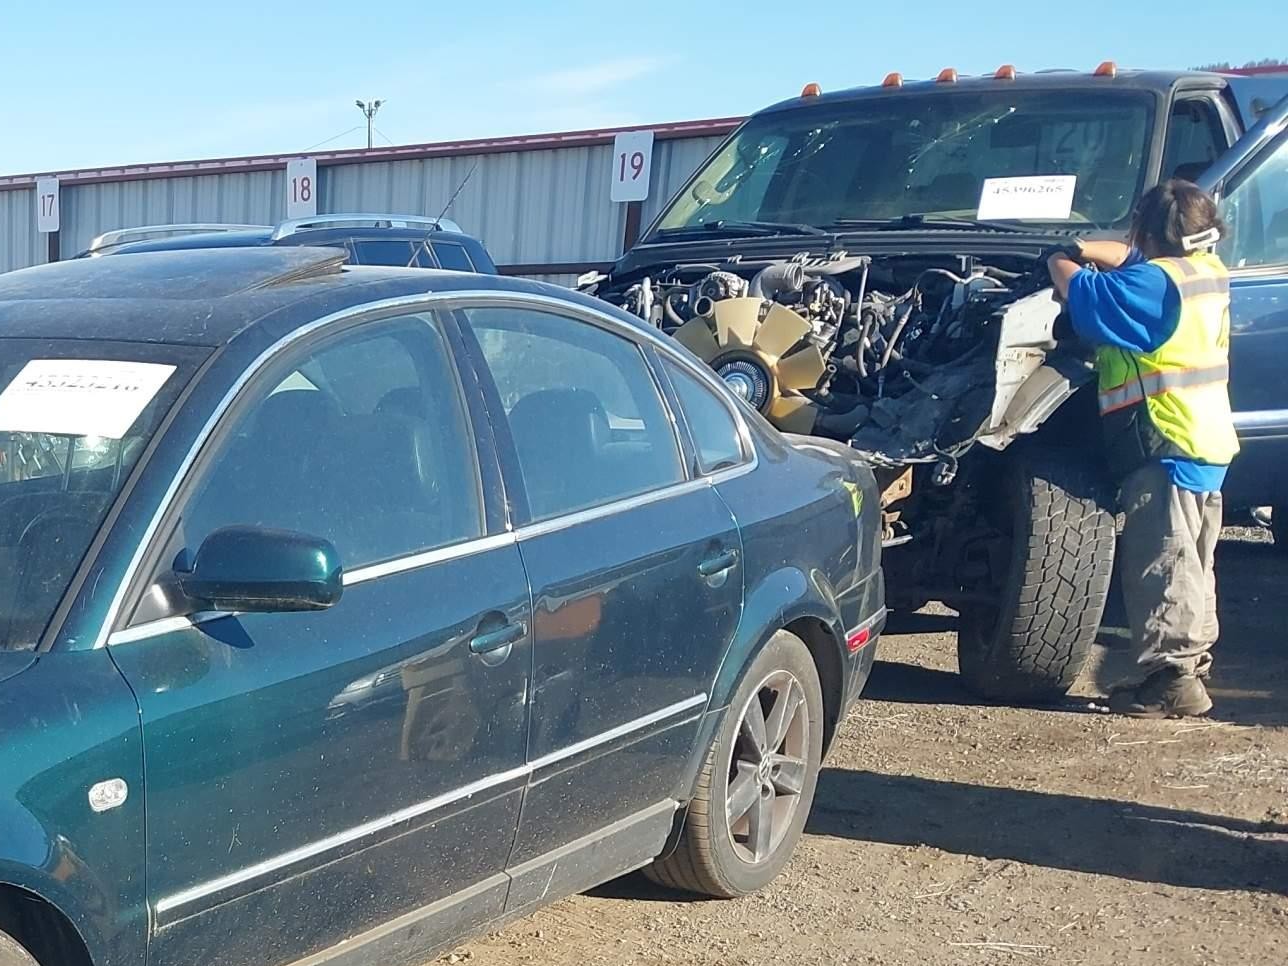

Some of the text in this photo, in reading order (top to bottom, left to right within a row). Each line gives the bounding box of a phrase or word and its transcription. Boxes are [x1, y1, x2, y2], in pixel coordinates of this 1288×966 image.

[620, 152, 644, 182] 19
[292, 176, 311, 203] 18
[41, 193, 55, 217] 17
